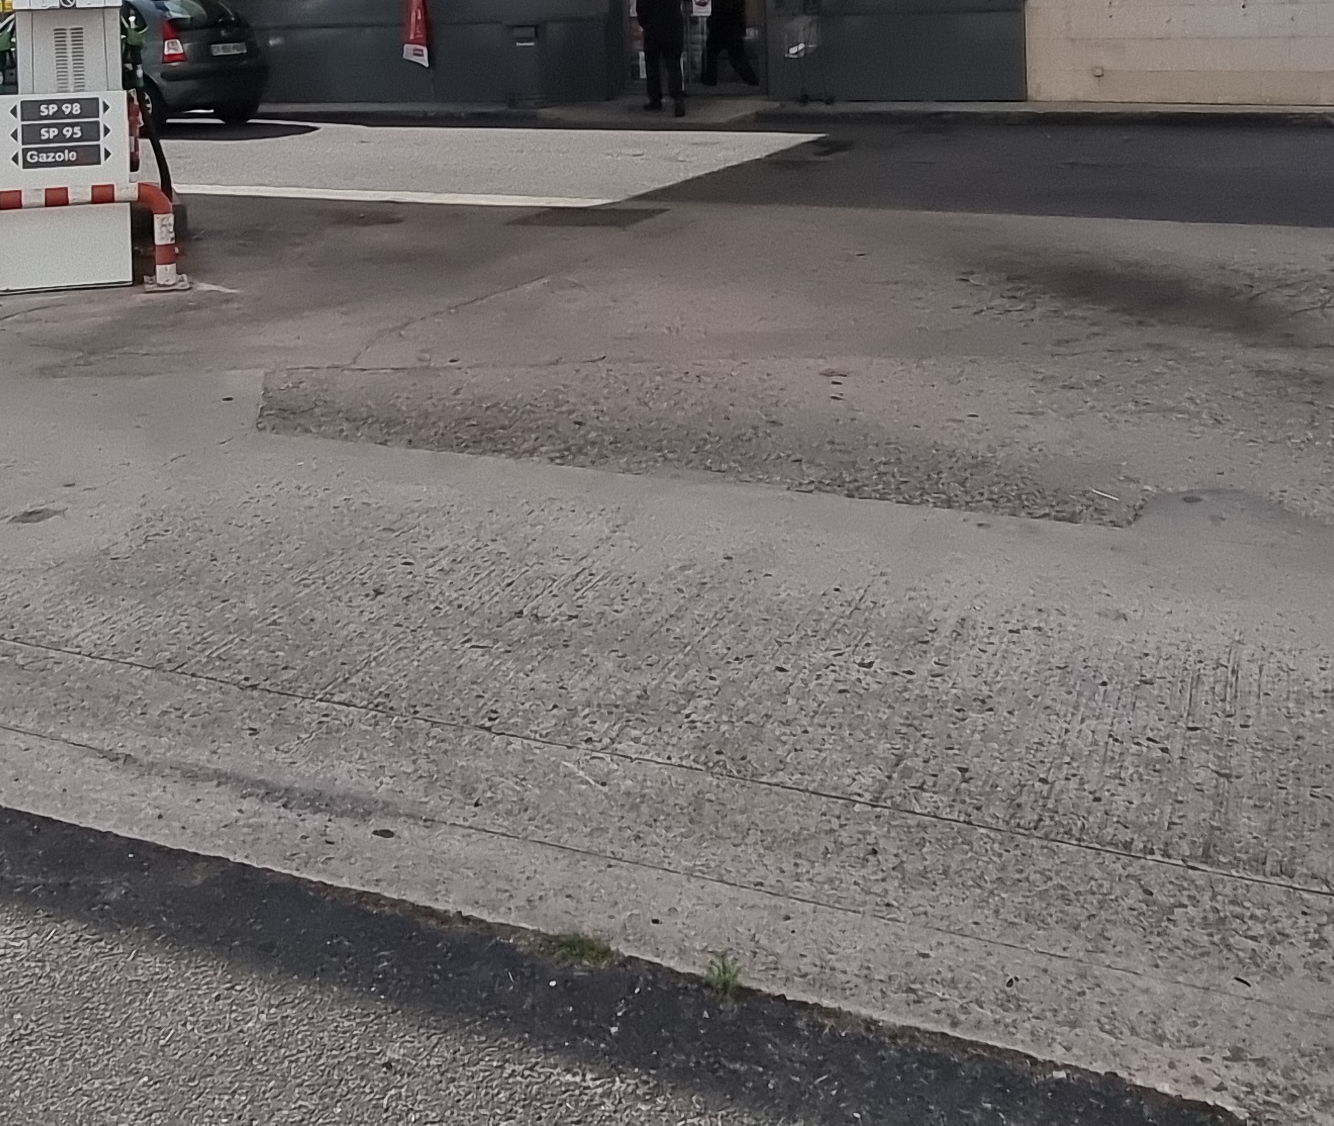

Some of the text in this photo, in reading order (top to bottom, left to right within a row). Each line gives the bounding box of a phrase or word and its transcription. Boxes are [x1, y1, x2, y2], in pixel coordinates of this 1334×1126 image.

[40, 103, 81, 115] SP 98
[40, 126, 82, 139] SP 95
